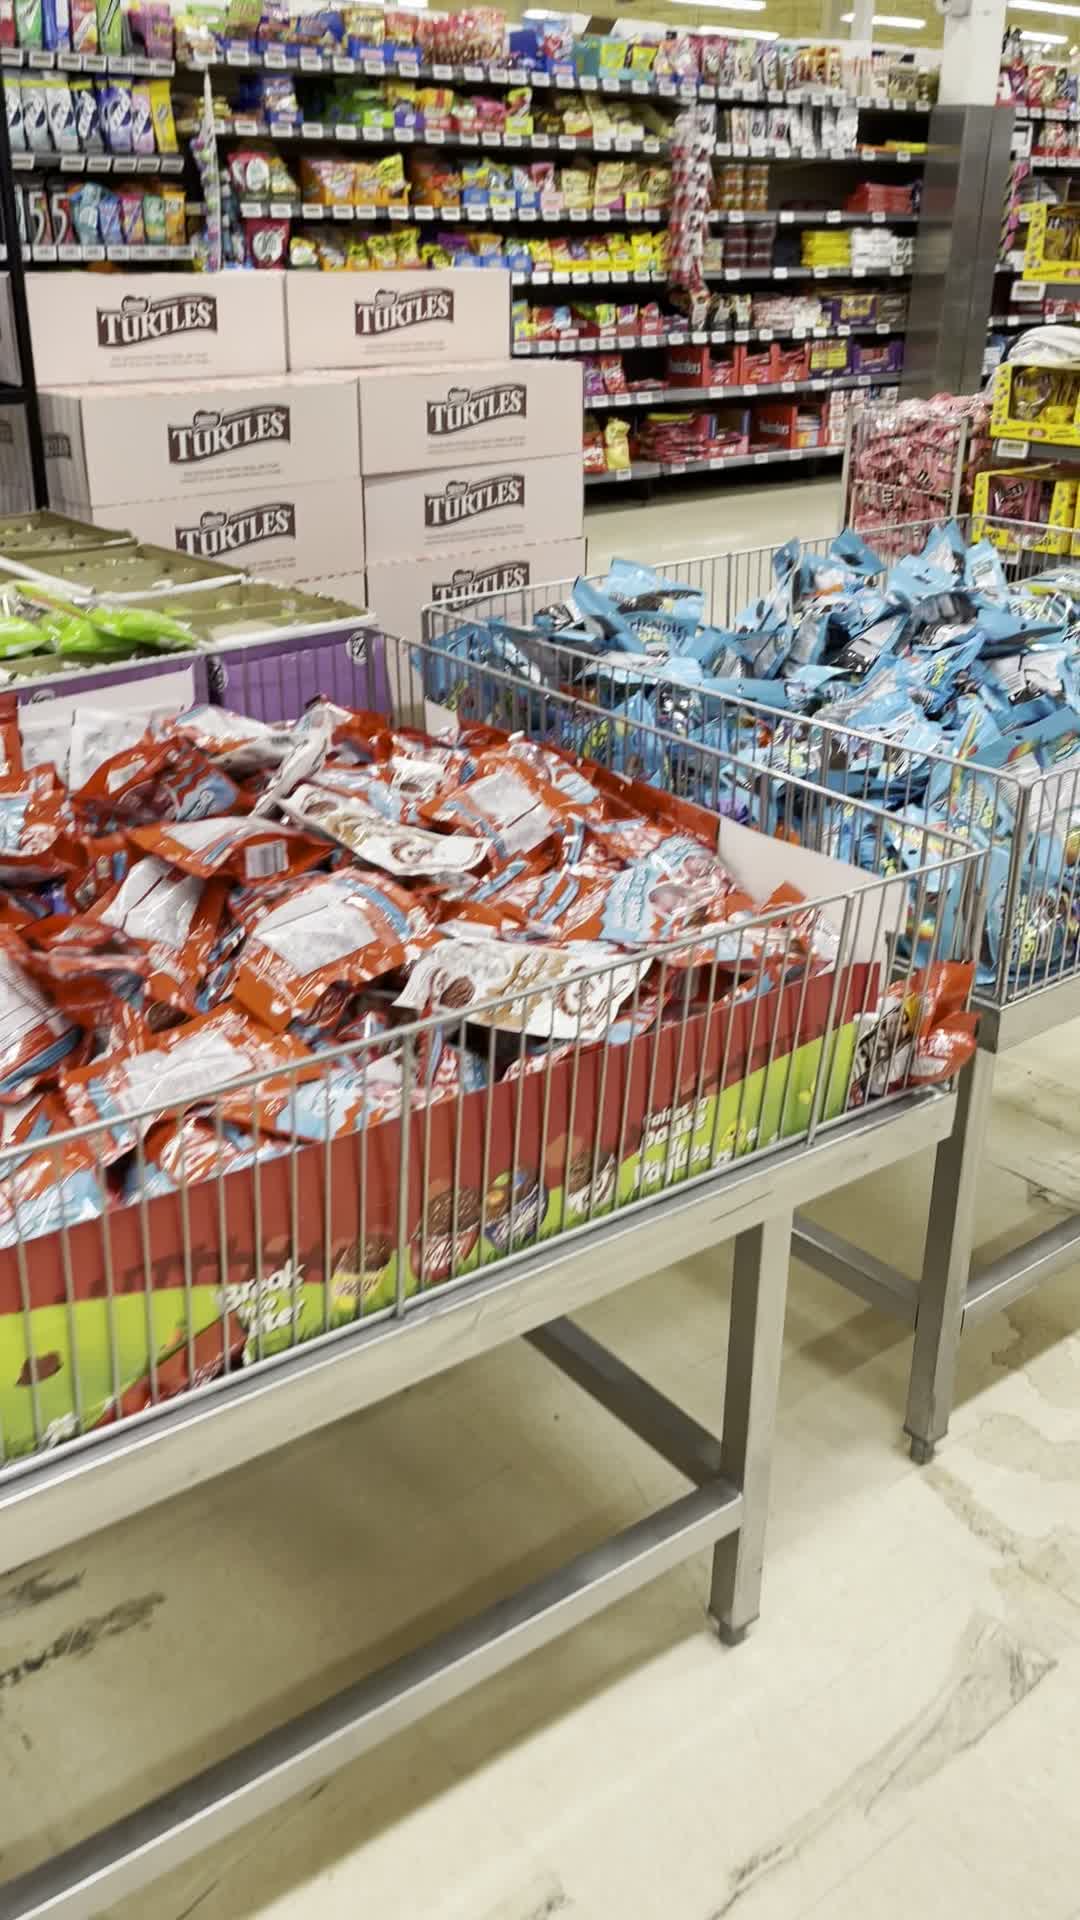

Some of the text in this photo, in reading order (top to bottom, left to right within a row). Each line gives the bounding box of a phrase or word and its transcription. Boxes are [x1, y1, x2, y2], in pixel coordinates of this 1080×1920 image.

[101, 301, 214, 345] TURTLES
[357, 294, 451, 334] TURTLES
[430, 389, 524, 433] TURTLES
[172, 411, 287, 460] TURTLES
[427, 480, 522, 524] TURTLES
[180, 508, 291, 556] TURTLES
[435, 567, 527, 610] TURTLES
